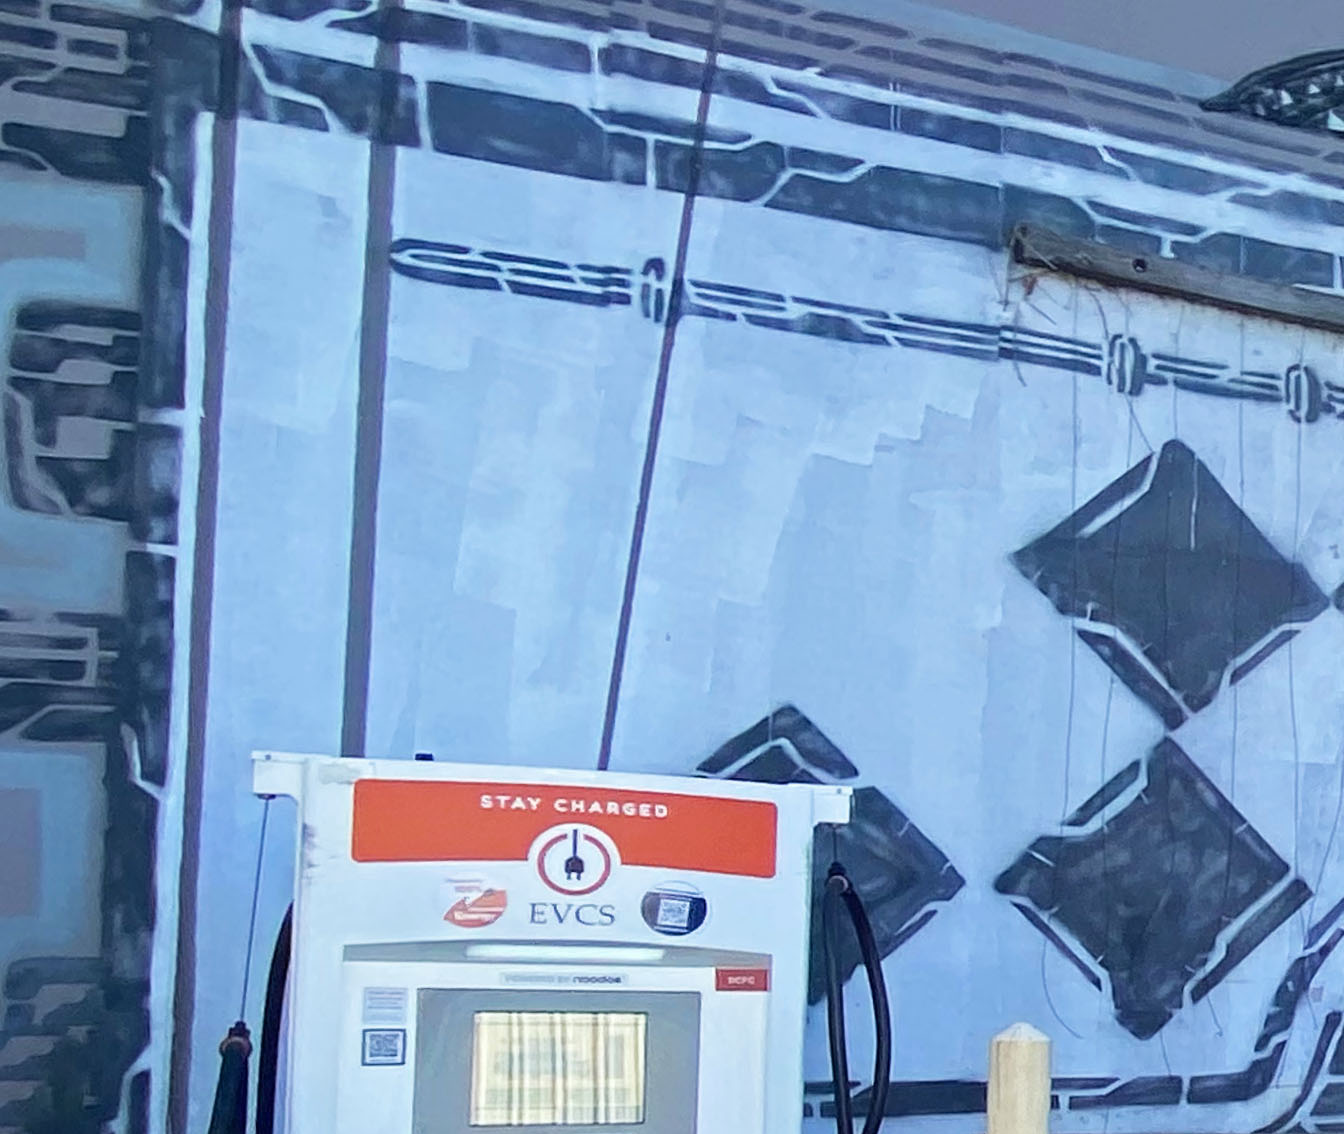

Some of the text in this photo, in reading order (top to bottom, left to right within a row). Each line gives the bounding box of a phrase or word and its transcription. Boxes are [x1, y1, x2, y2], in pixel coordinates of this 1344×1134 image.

[480, 795, 668, 818] STAY CHARGED
[529, 902, 616, 926] EVCS
